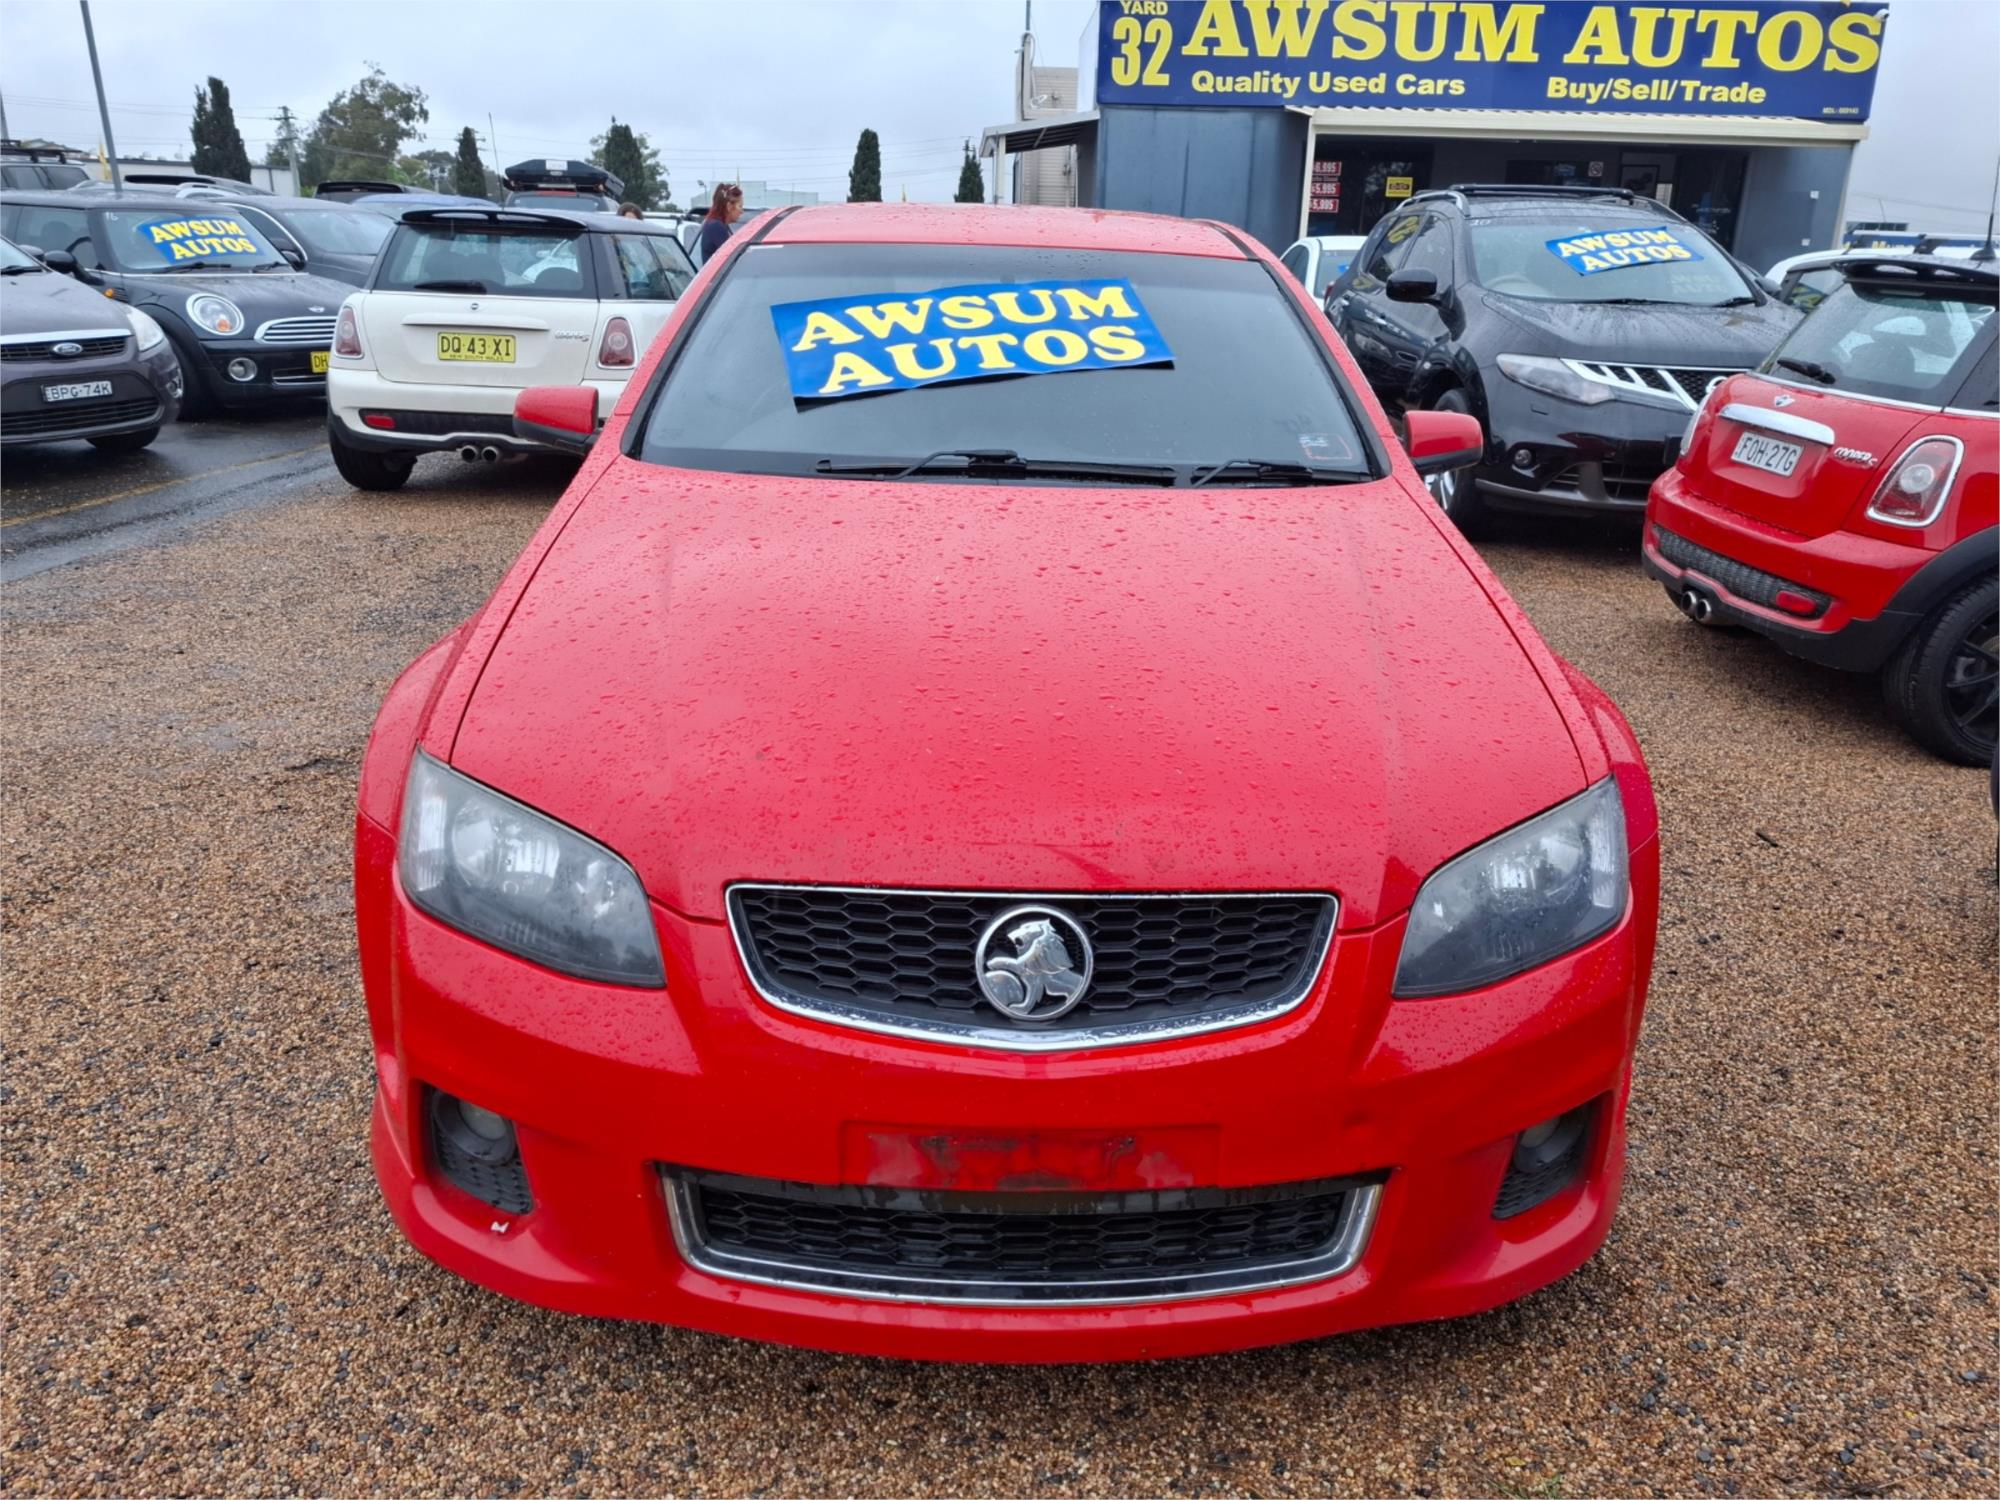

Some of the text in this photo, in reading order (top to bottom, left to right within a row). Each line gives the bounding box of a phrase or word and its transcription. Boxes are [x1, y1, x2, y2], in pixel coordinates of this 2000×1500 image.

[1121, 0, 1168, 15] YARD
[1182, 0, 1883, 73] AWSUM AUTOS
[1111, 17, 1173, 86] 32
[1192, 70, 1465, 98] Quality Used Cars
[150, 219, 245, 243] AWSUM
[1557, 229, 1679, 257] AWSUM
[170, 238, 257, 259] AUTOS
[1581, 244, 1692, 271] AUTOS
[792, 286, 1140, 352] AWSUM
[819, 325, 1146, 394] AUTOS
